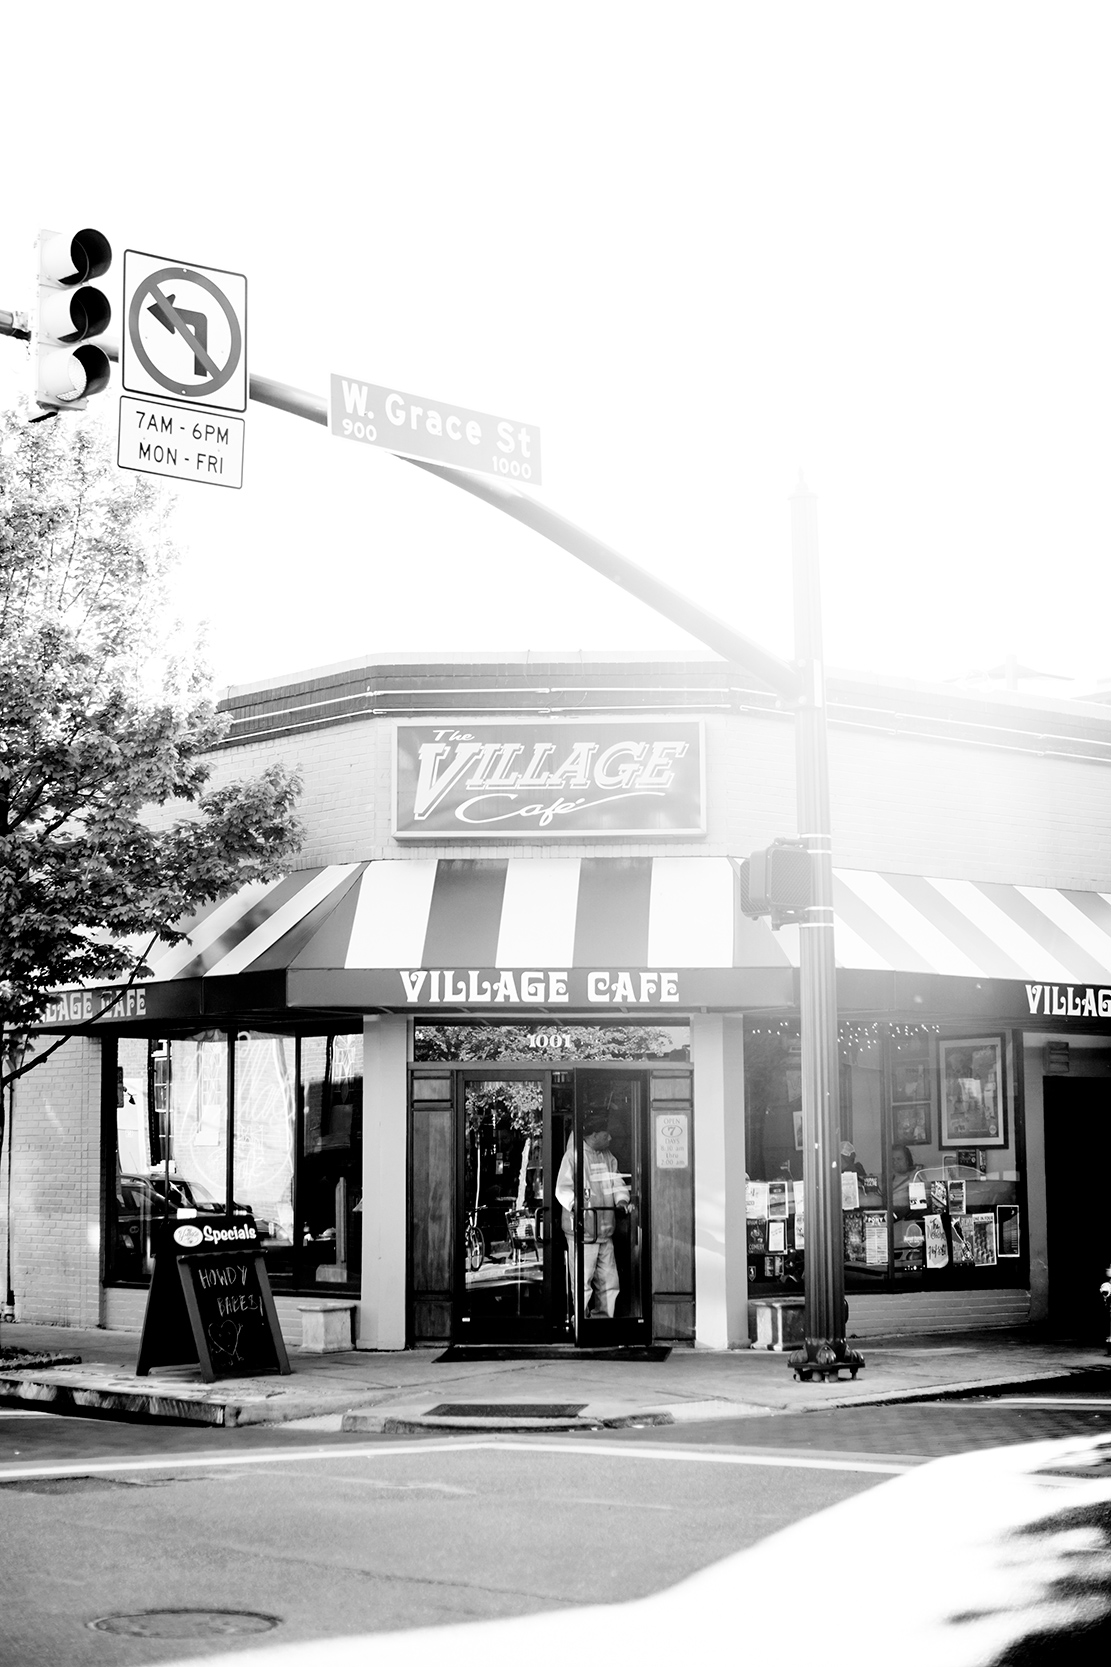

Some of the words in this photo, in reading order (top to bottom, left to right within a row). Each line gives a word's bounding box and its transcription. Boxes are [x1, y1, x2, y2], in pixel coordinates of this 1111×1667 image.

[136, 410, 173, 435] 7AM
[192, 423, 229, 445] 6PM
[341, 380, 375, 419] W.
[385, 393, 482, 446] Grace
[496, 421, 531, 458] St
[138, 442, 177, 466] MON
[196, 453, 223, 474] FRI
[342, 418, 377, 442] 900
[492, 455, 532, 479] 1000
[432, 729, 475, 741] The
[413, 741, 690, 821] VILLAGE
[399, 970, 570, 1003] VILLAGE
[587, 971, 680, 1003] CAFE
[527, 1033, 572, 1049] 1001
[667, 1126, 676, 1136] 7
[203, 1223, 257, 1245] Specials
[198, 1264, 248, 1290] HOWDY
